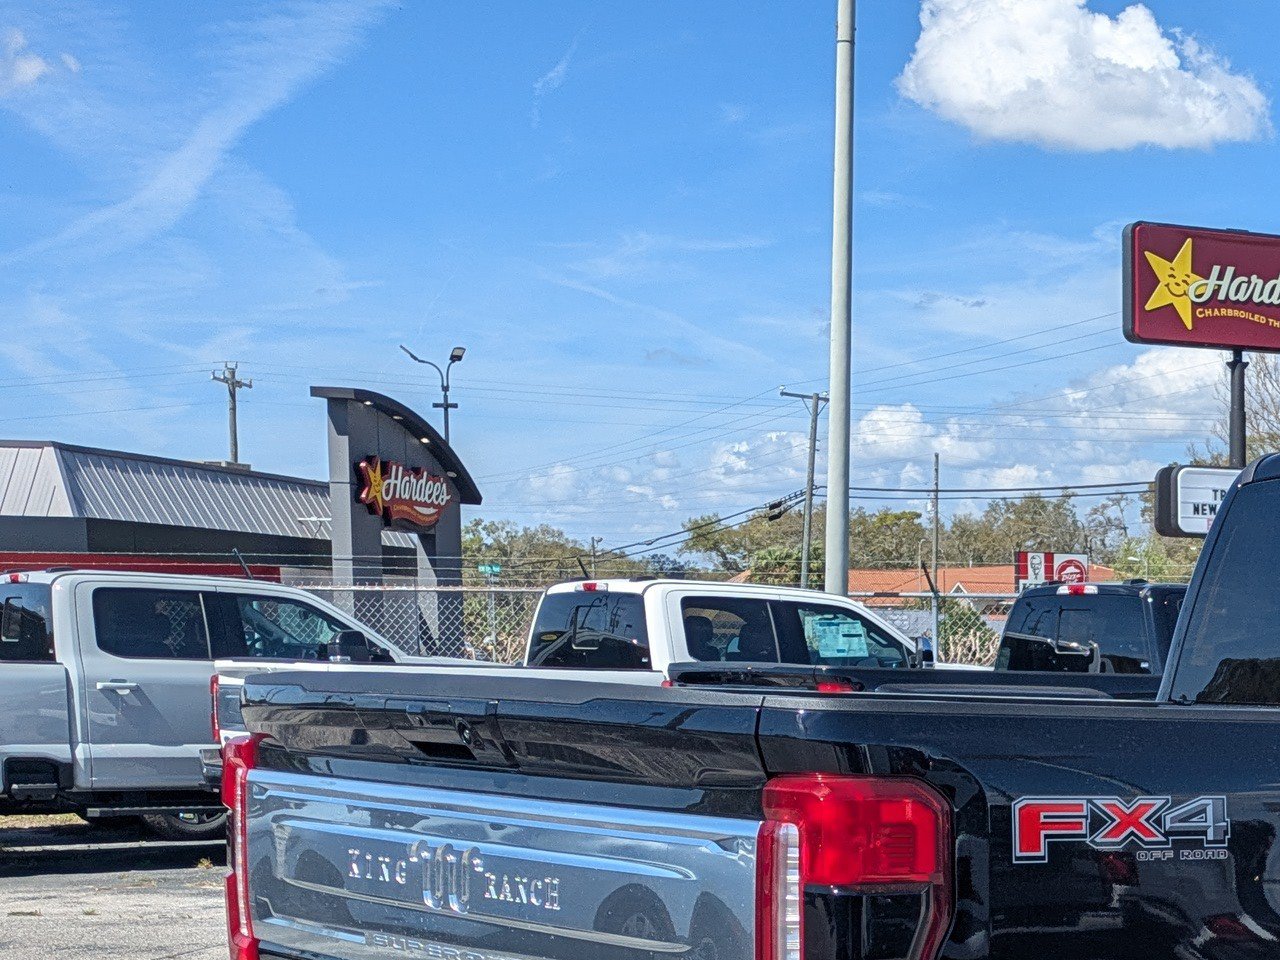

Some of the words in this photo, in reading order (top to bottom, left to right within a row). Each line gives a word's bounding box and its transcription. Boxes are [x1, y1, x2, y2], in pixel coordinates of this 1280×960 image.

[382, 465, 451, 506] Hardee's
[1193, 503, 1217, 516] NEW
[1012, 795, 1231, 864] FX4
[1136, 850, 1174, 862] OFF
[1179, 849, 1229, 861] ROAD
[348, 848, 407, 885] KING
[484, 871, 561, 911] RANCH
